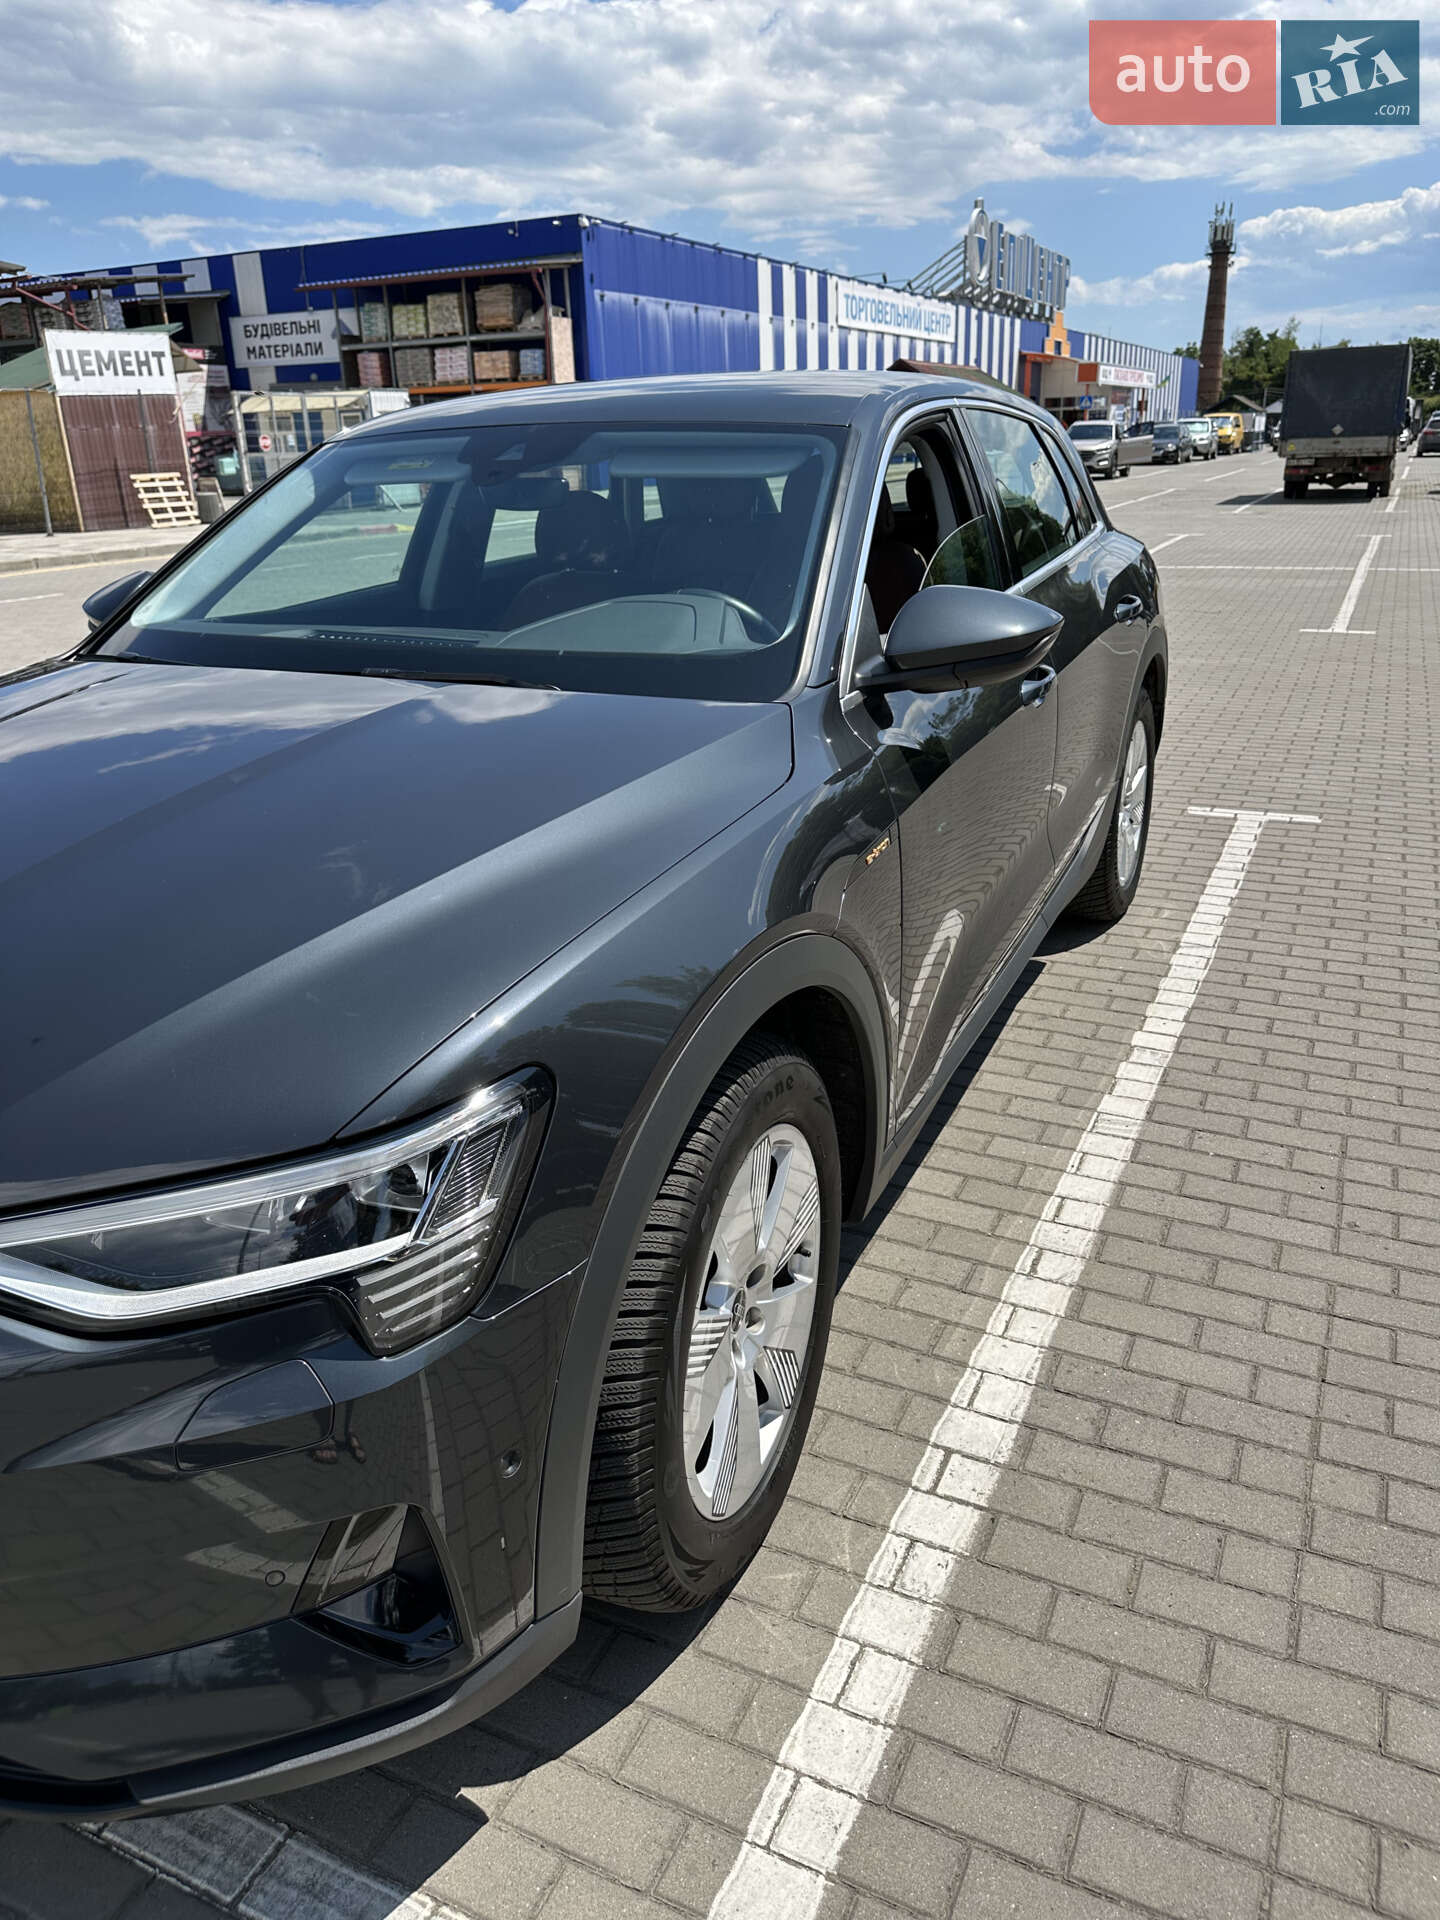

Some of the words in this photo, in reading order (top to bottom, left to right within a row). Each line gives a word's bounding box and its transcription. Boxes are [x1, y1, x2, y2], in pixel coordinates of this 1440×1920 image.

[843, 293, 921, 331] ТОРГОВЕЛЬНИЙ
[923, 309, 952, 336] ЦЕНТР
[243, 319, 321, 340] БУДІВЕЛЬНІ
[246, 341, 324, 360] МАТЕРІАЛИ
[55, 348, 166, 382] ЦЕМЕНТ
